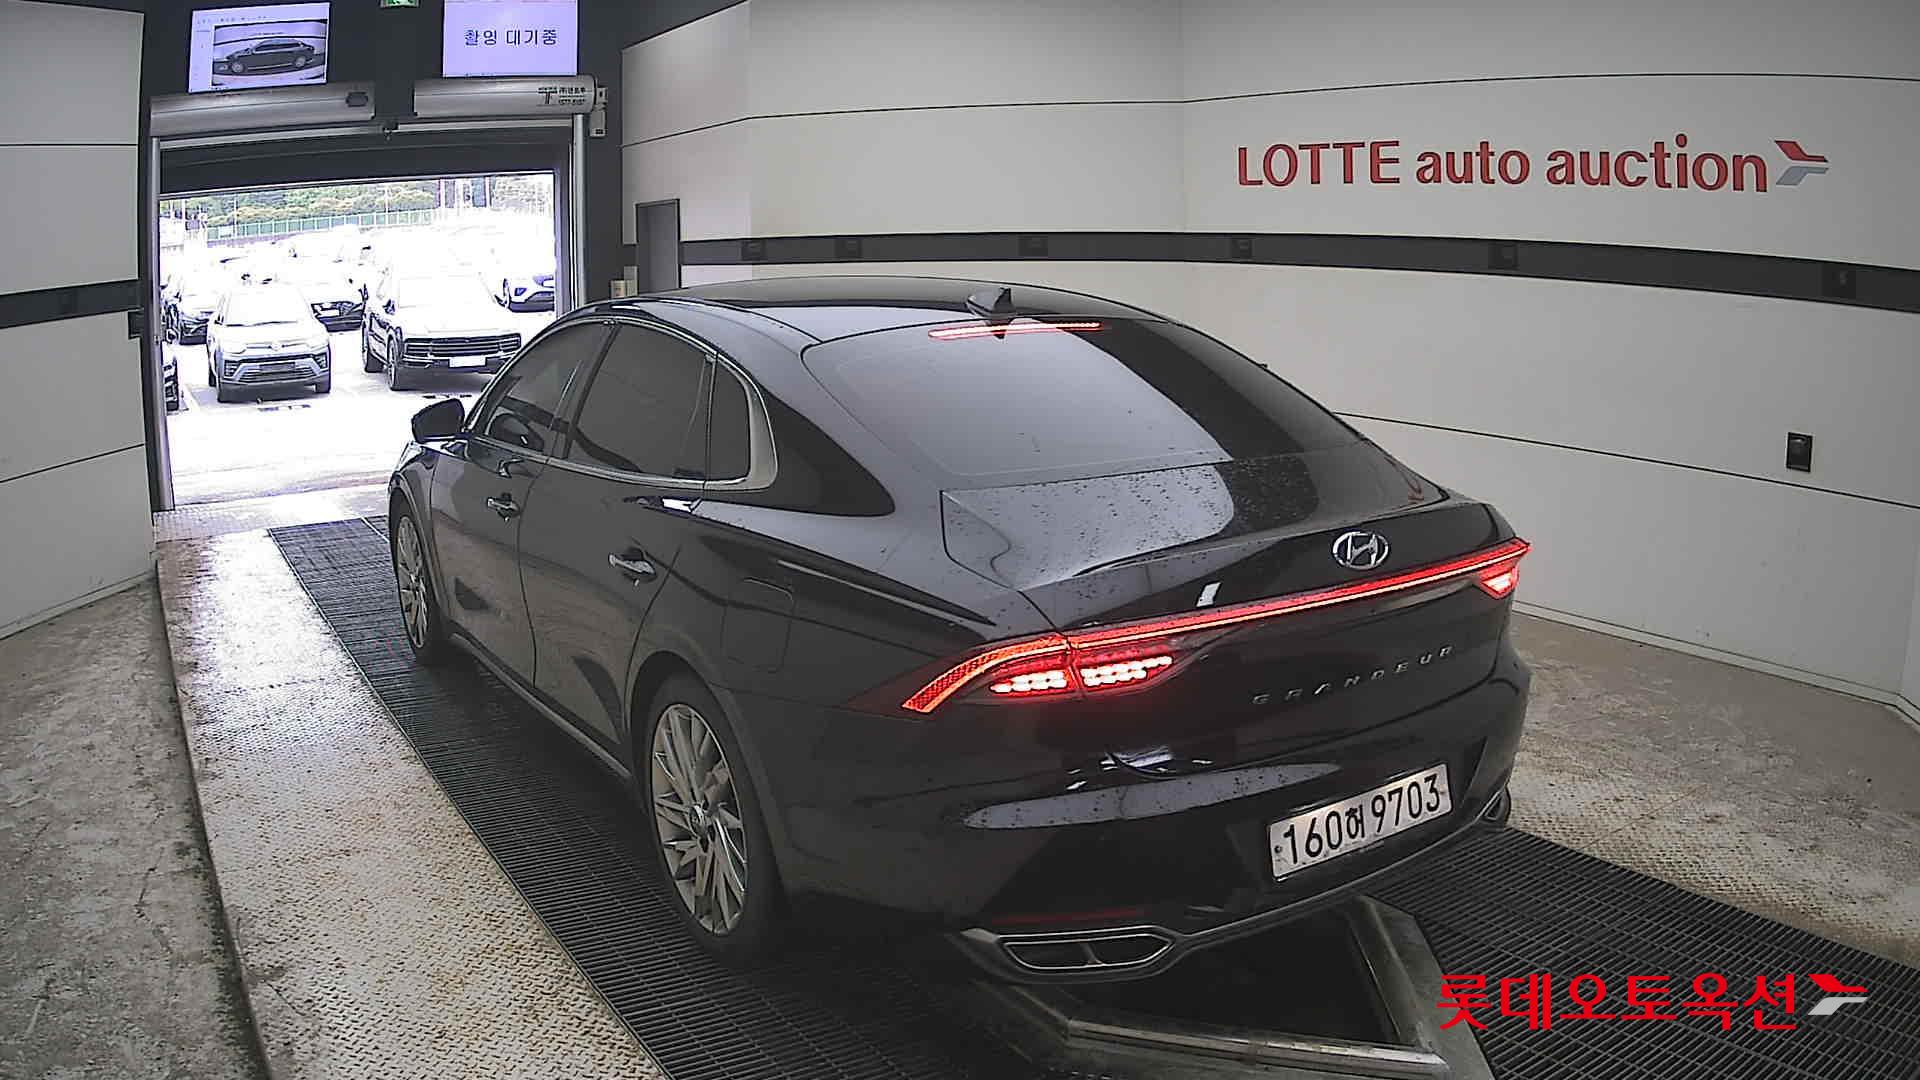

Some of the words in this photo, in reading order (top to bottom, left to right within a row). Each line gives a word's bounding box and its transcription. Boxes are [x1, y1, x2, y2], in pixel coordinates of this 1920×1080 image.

[464, 28, 498, 46] 촬영
[505, 28, 558, 46] 대기중
[1237, 139, 1400, 187] LOTTE
[1415, 140, 1531, 186] auto
[1546, 133, 1769, 194] auction
[1252, 645, 1453, 704] GRANDEUR
[1282, 804, 1366, 865] 160허
[1371, 772, 1442, 834] 9703
